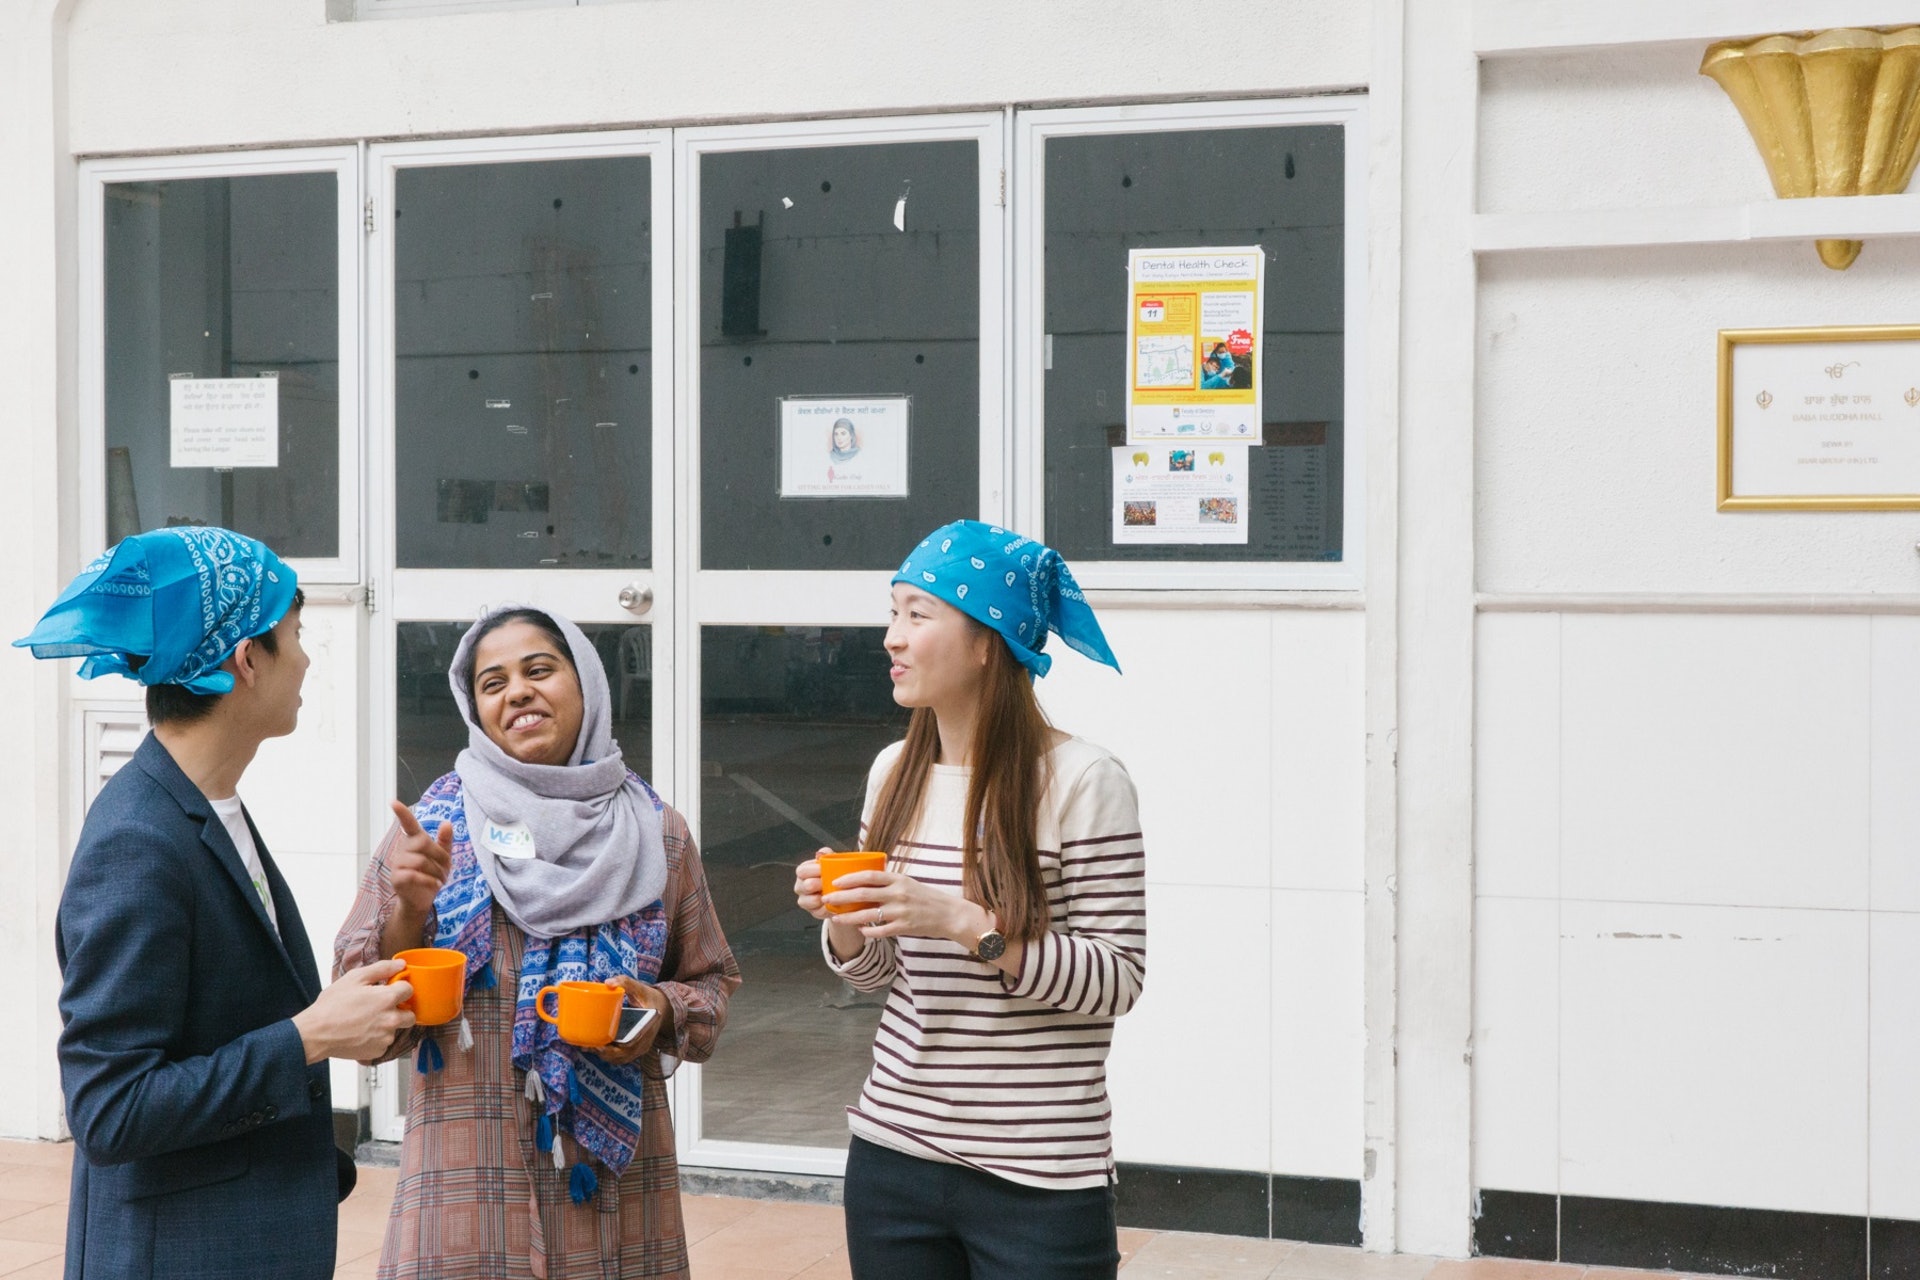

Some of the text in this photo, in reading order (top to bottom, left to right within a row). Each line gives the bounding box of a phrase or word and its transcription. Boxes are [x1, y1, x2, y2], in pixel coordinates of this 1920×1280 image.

[1142, 258, 1248, 270] Dental Health Check
[1231, 335, 1250, 344] Free
[1819, 413, 1858, 421] BUDDHA
[1860, 413, 1883, 421] HALL
